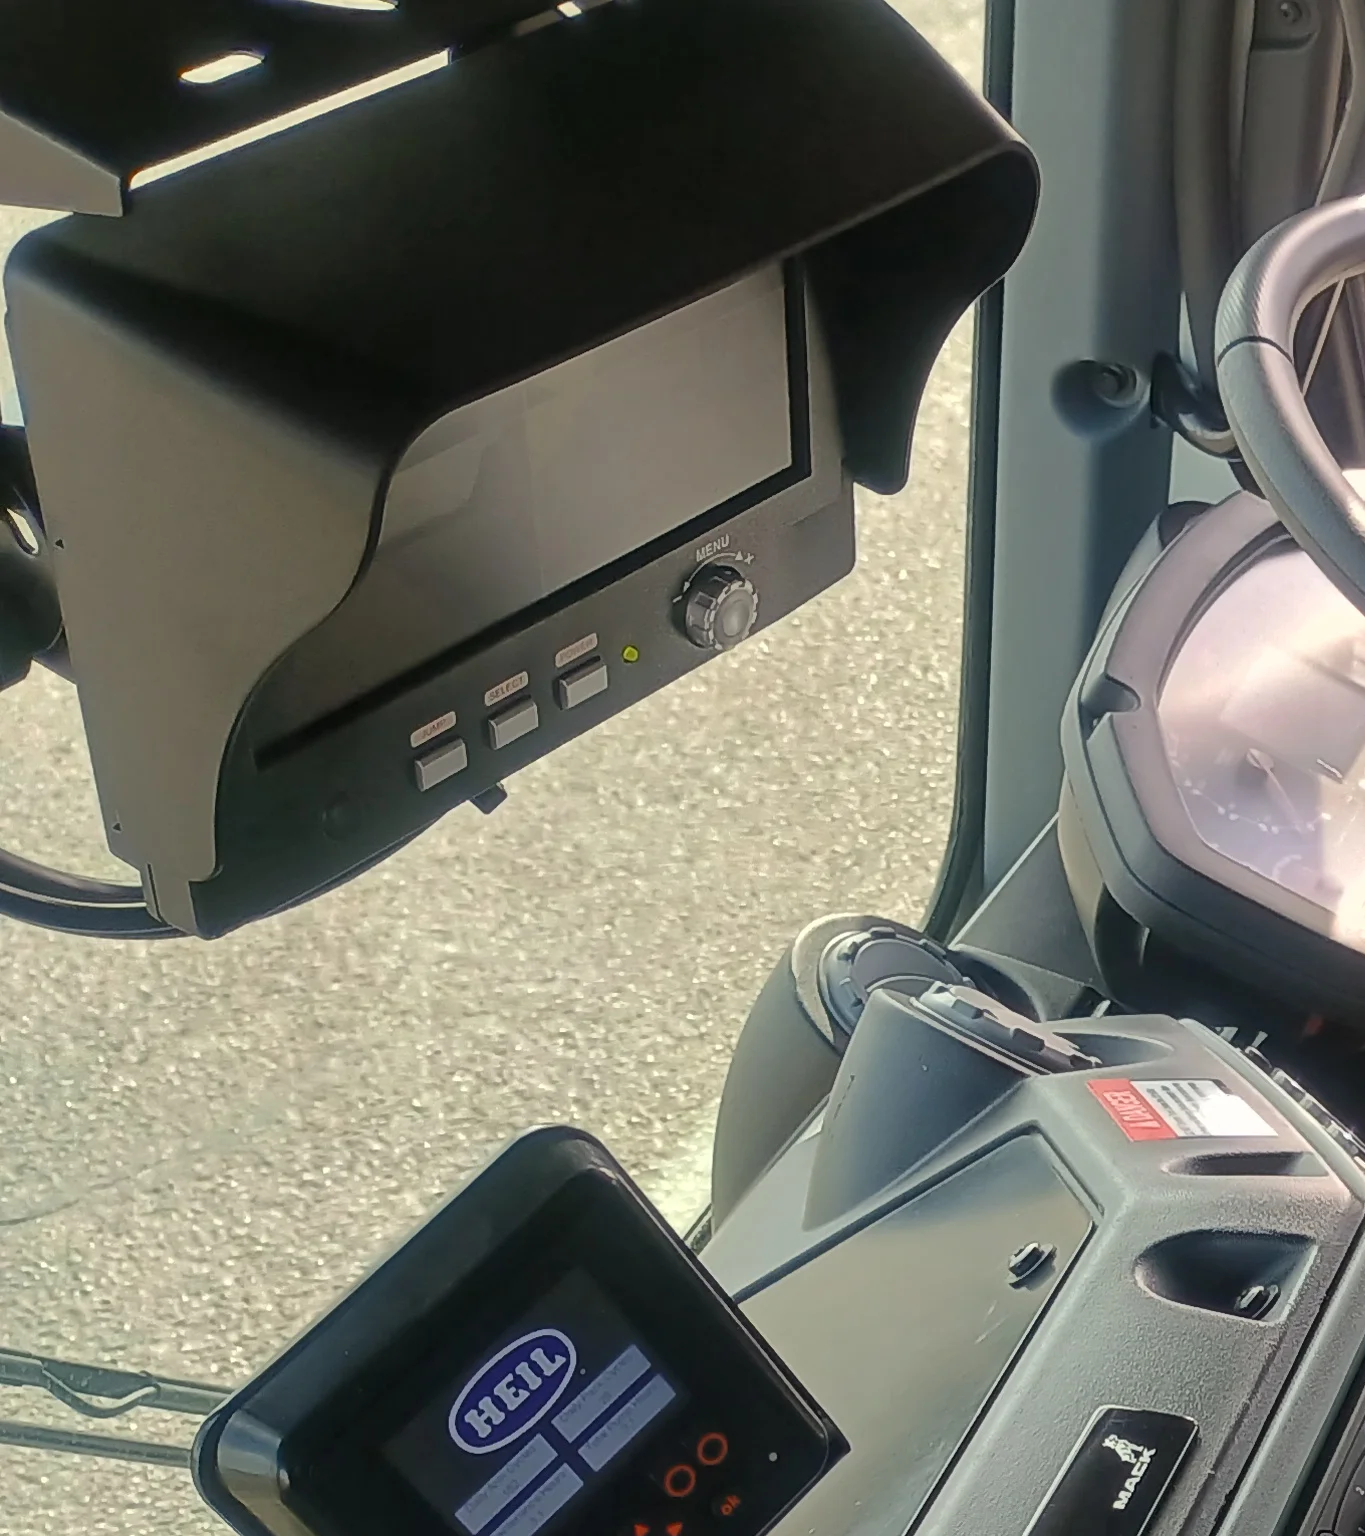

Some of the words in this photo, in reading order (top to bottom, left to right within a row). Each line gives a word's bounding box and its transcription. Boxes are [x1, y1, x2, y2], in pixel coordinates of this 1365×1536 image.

[696, 534, 730, 562] MENU
[487, 676, 525, 702] SELECT
[464, 1347, 567, 1439] HEIL
[1112, 1448, 1157, 1510] MACK
